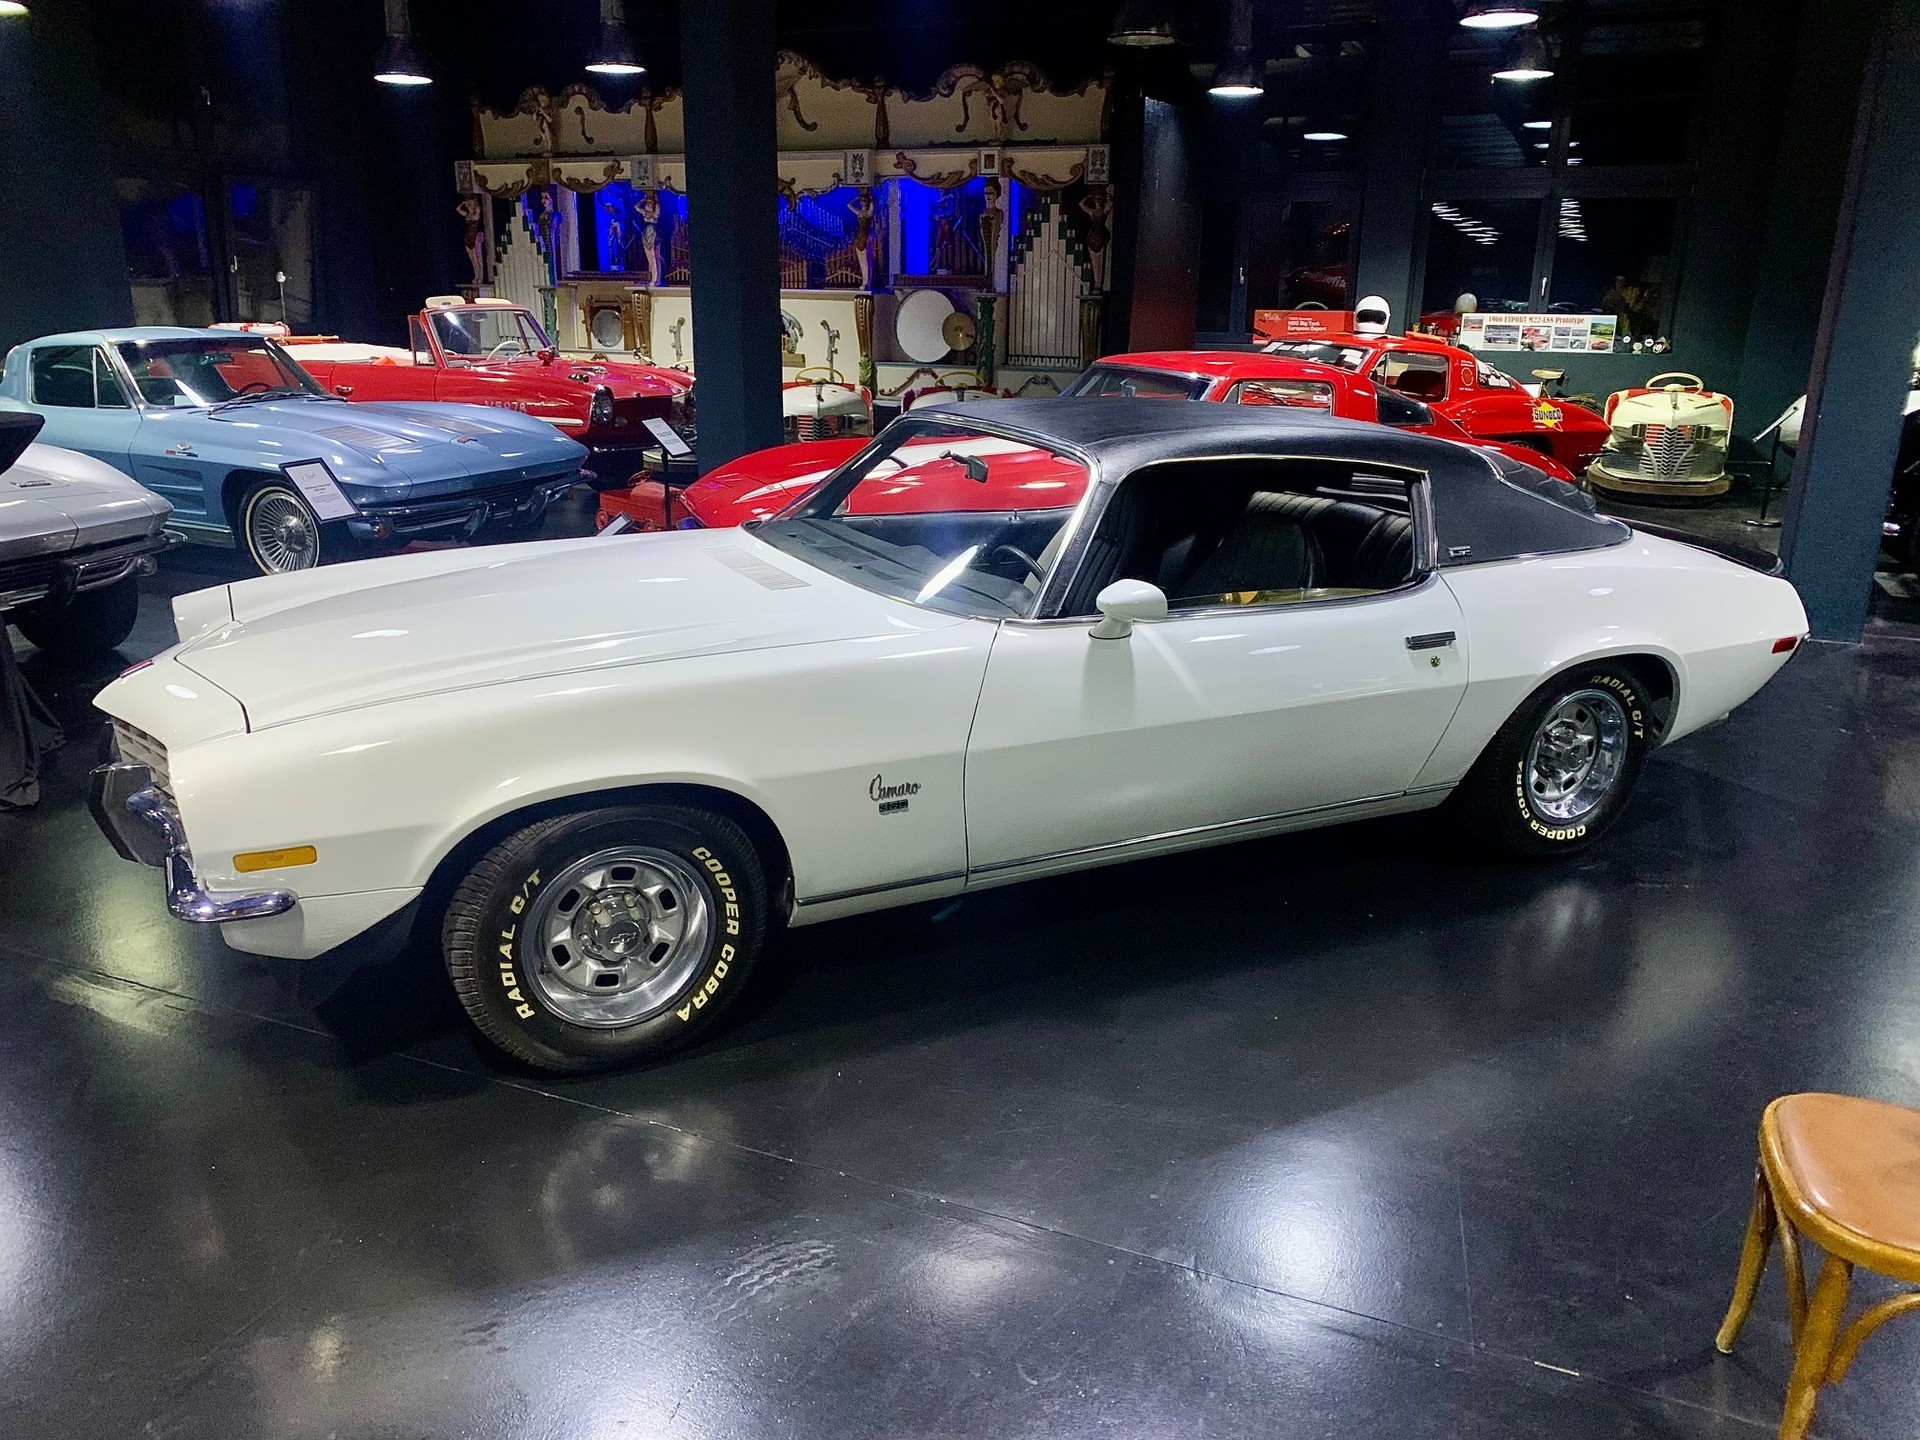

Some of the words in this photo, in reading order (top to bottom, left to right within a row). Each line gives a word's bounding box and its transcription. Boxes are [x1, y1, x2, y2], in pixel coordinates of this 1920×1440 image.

[1555, 317, 1585, 325] Prototype
[1534, 408, 1562, 420] SUNOCO
[1589, 675, 1637, 707] RADIAL
[869, 773, 922, 802] Camaro
[1530, 819, 1586, 841] COOPER
[691, 846, 740, 936] COOPER
[499, 924, 536, 1020] RADIAL
[676, 943, 736, 1022] COBRA
